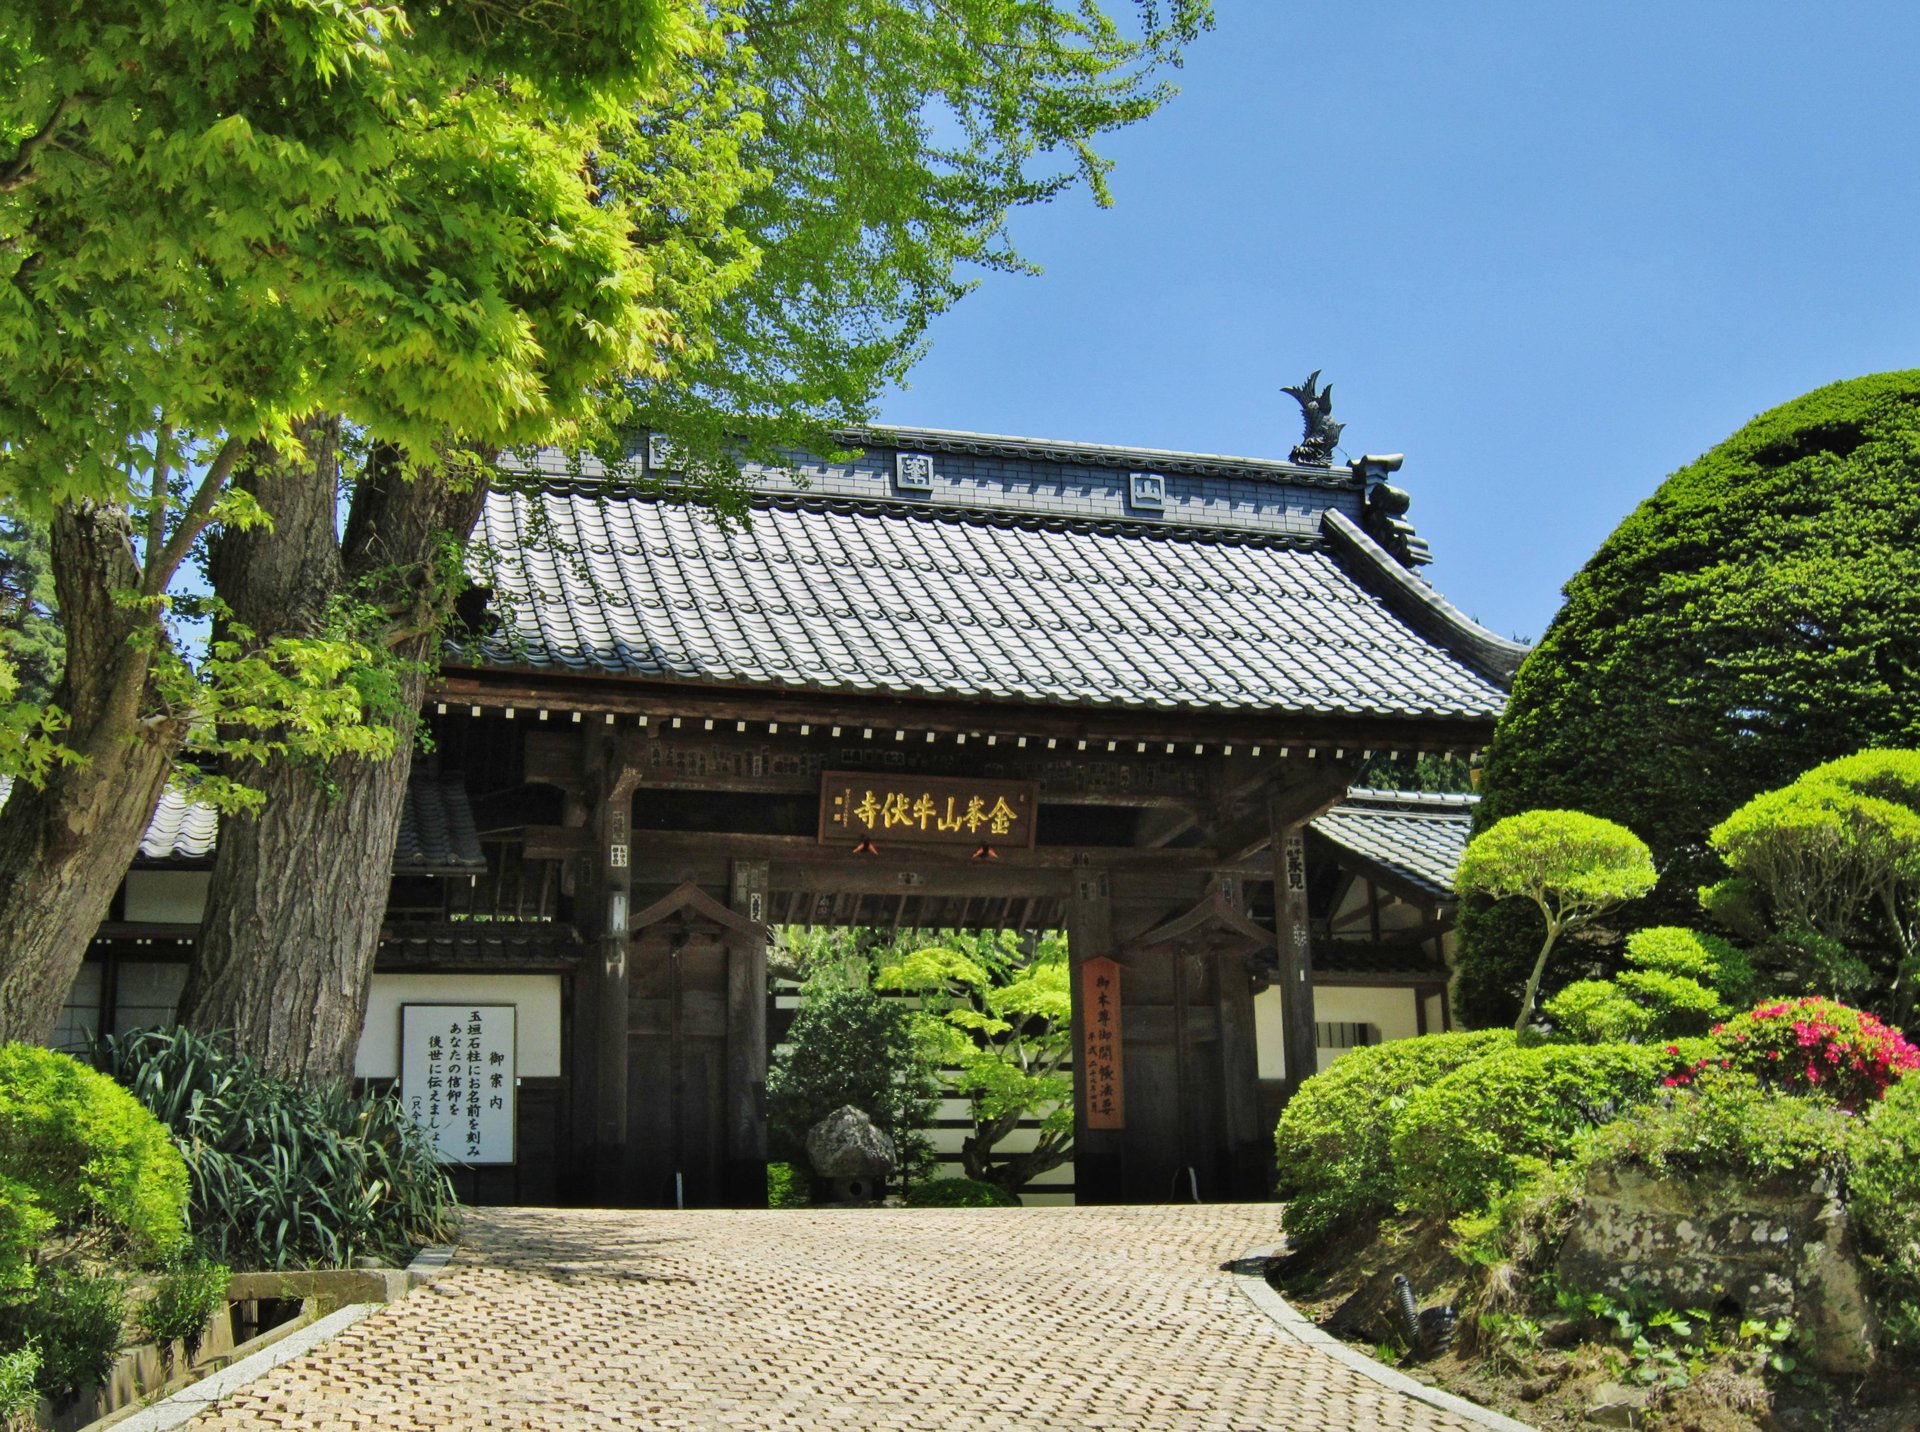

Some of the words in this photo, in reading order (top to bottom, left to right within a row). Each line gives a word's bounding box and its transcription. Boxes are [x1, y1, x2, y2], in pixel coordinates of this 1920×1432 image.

[1135, 480, 1161, 501] 山
[426, 1035, 444, 1154] 後世に伝えましょう
[447, 1022, 462, 1116] あなたの信仰を
[465, 1010, 482, 1157] 玉垣石柱にお名前を刻み
[488, 1051, 504, 1111] 御案内
